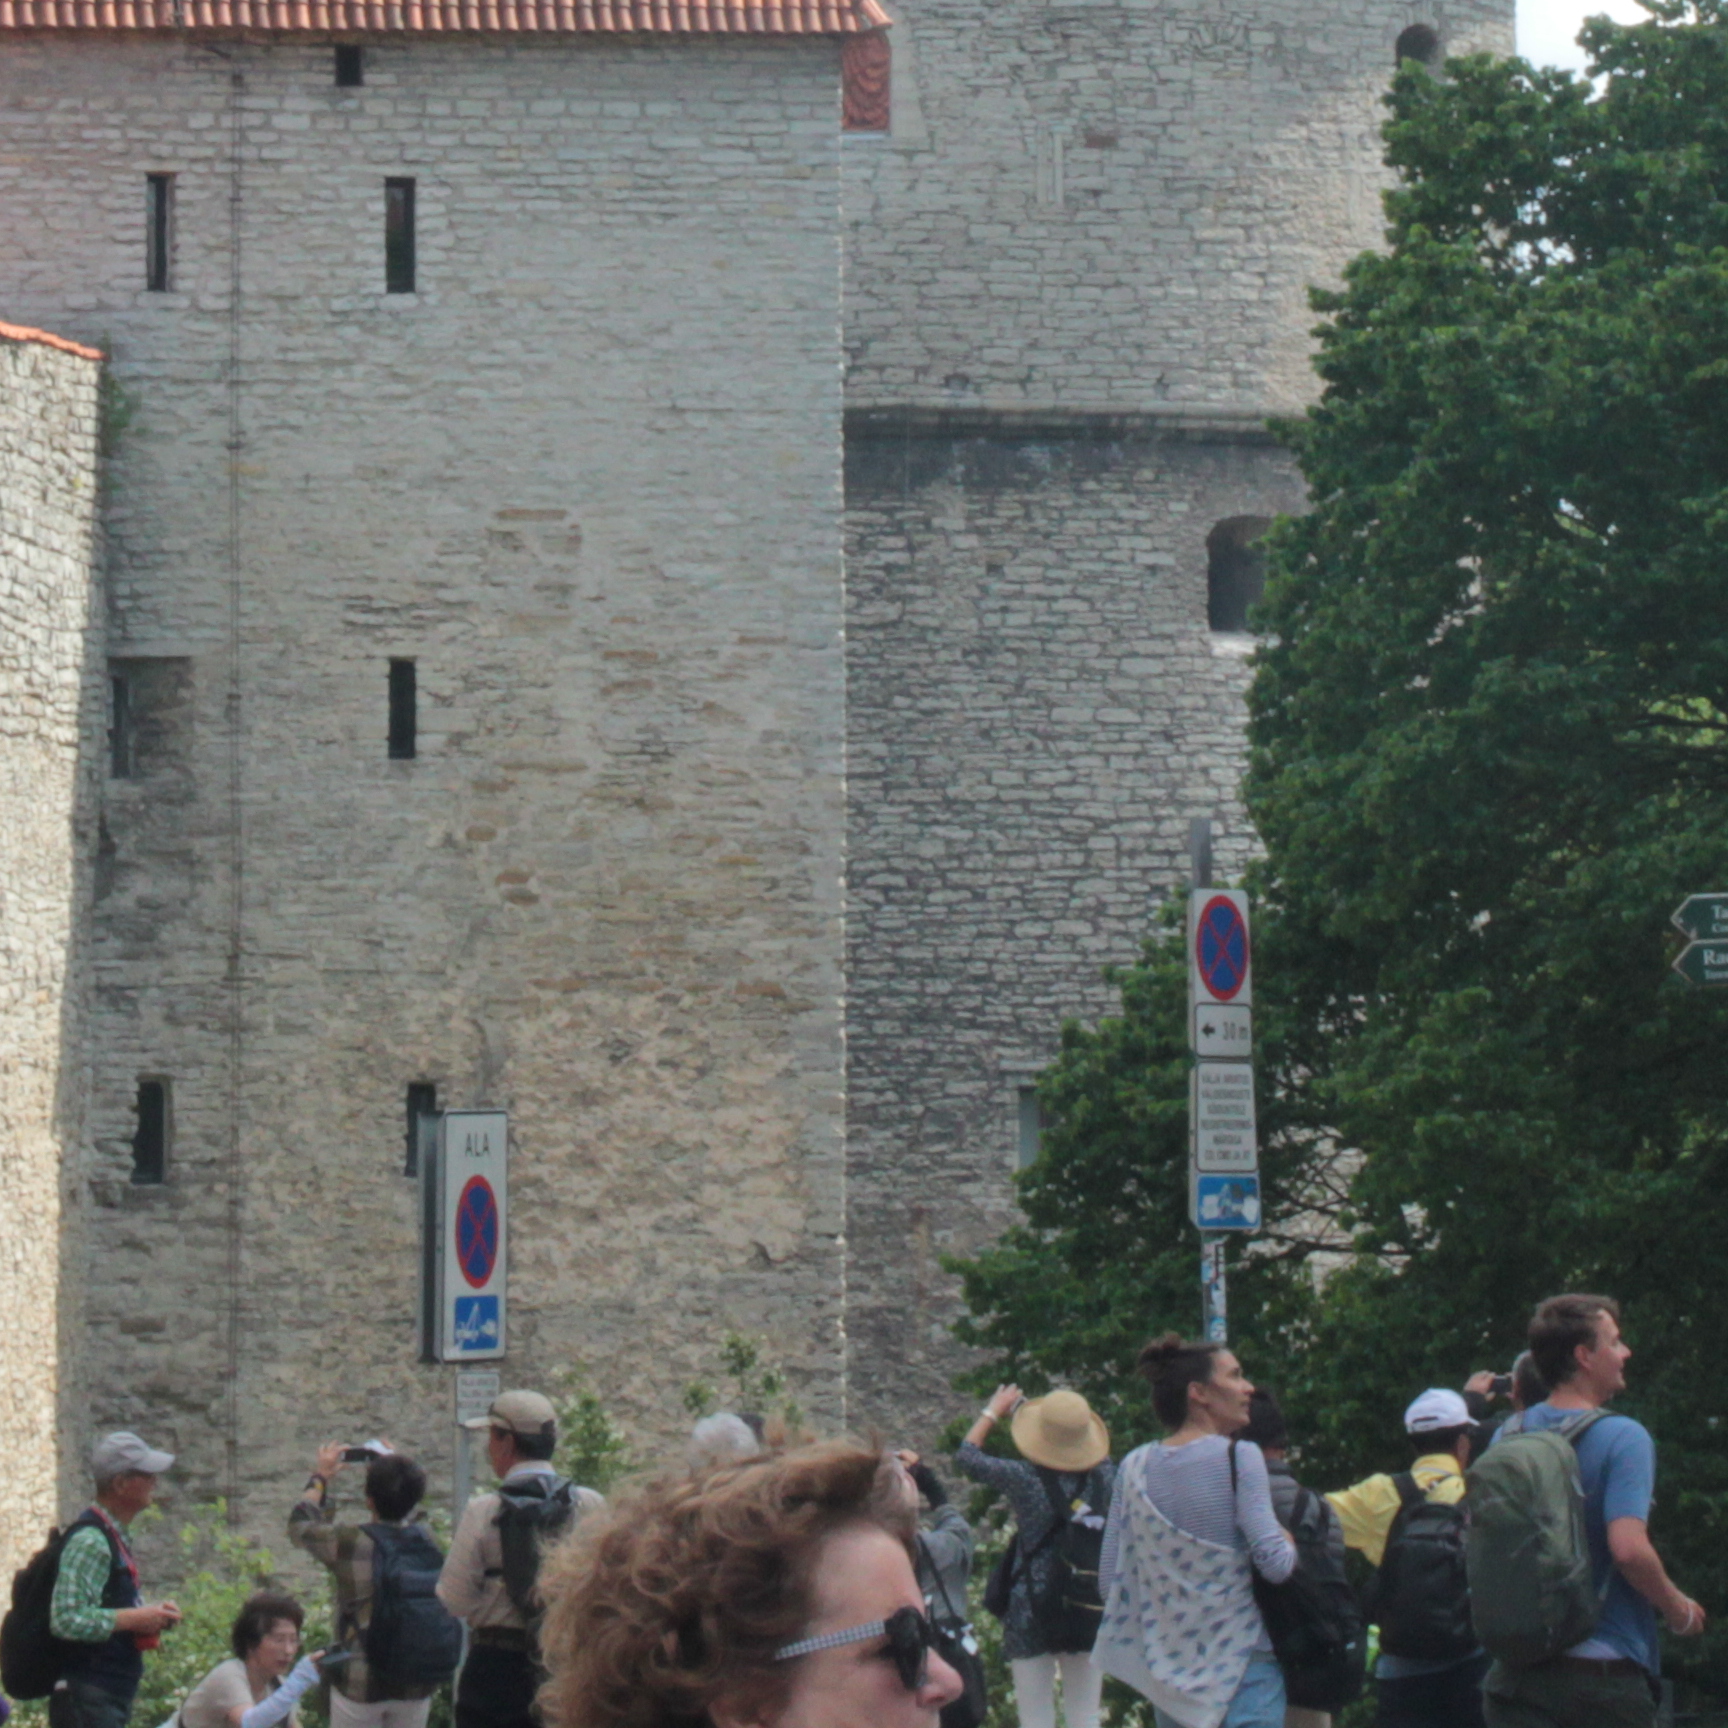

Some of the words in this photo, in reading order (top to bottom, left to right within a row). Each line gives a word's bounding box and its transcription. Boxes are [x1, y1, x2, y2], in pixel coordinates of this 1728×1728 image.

[1223, 1021, 1236, 1040] 30
[1238, 1026, 1248, 1040] m
[465, 1133, 490, 1157] ALA
